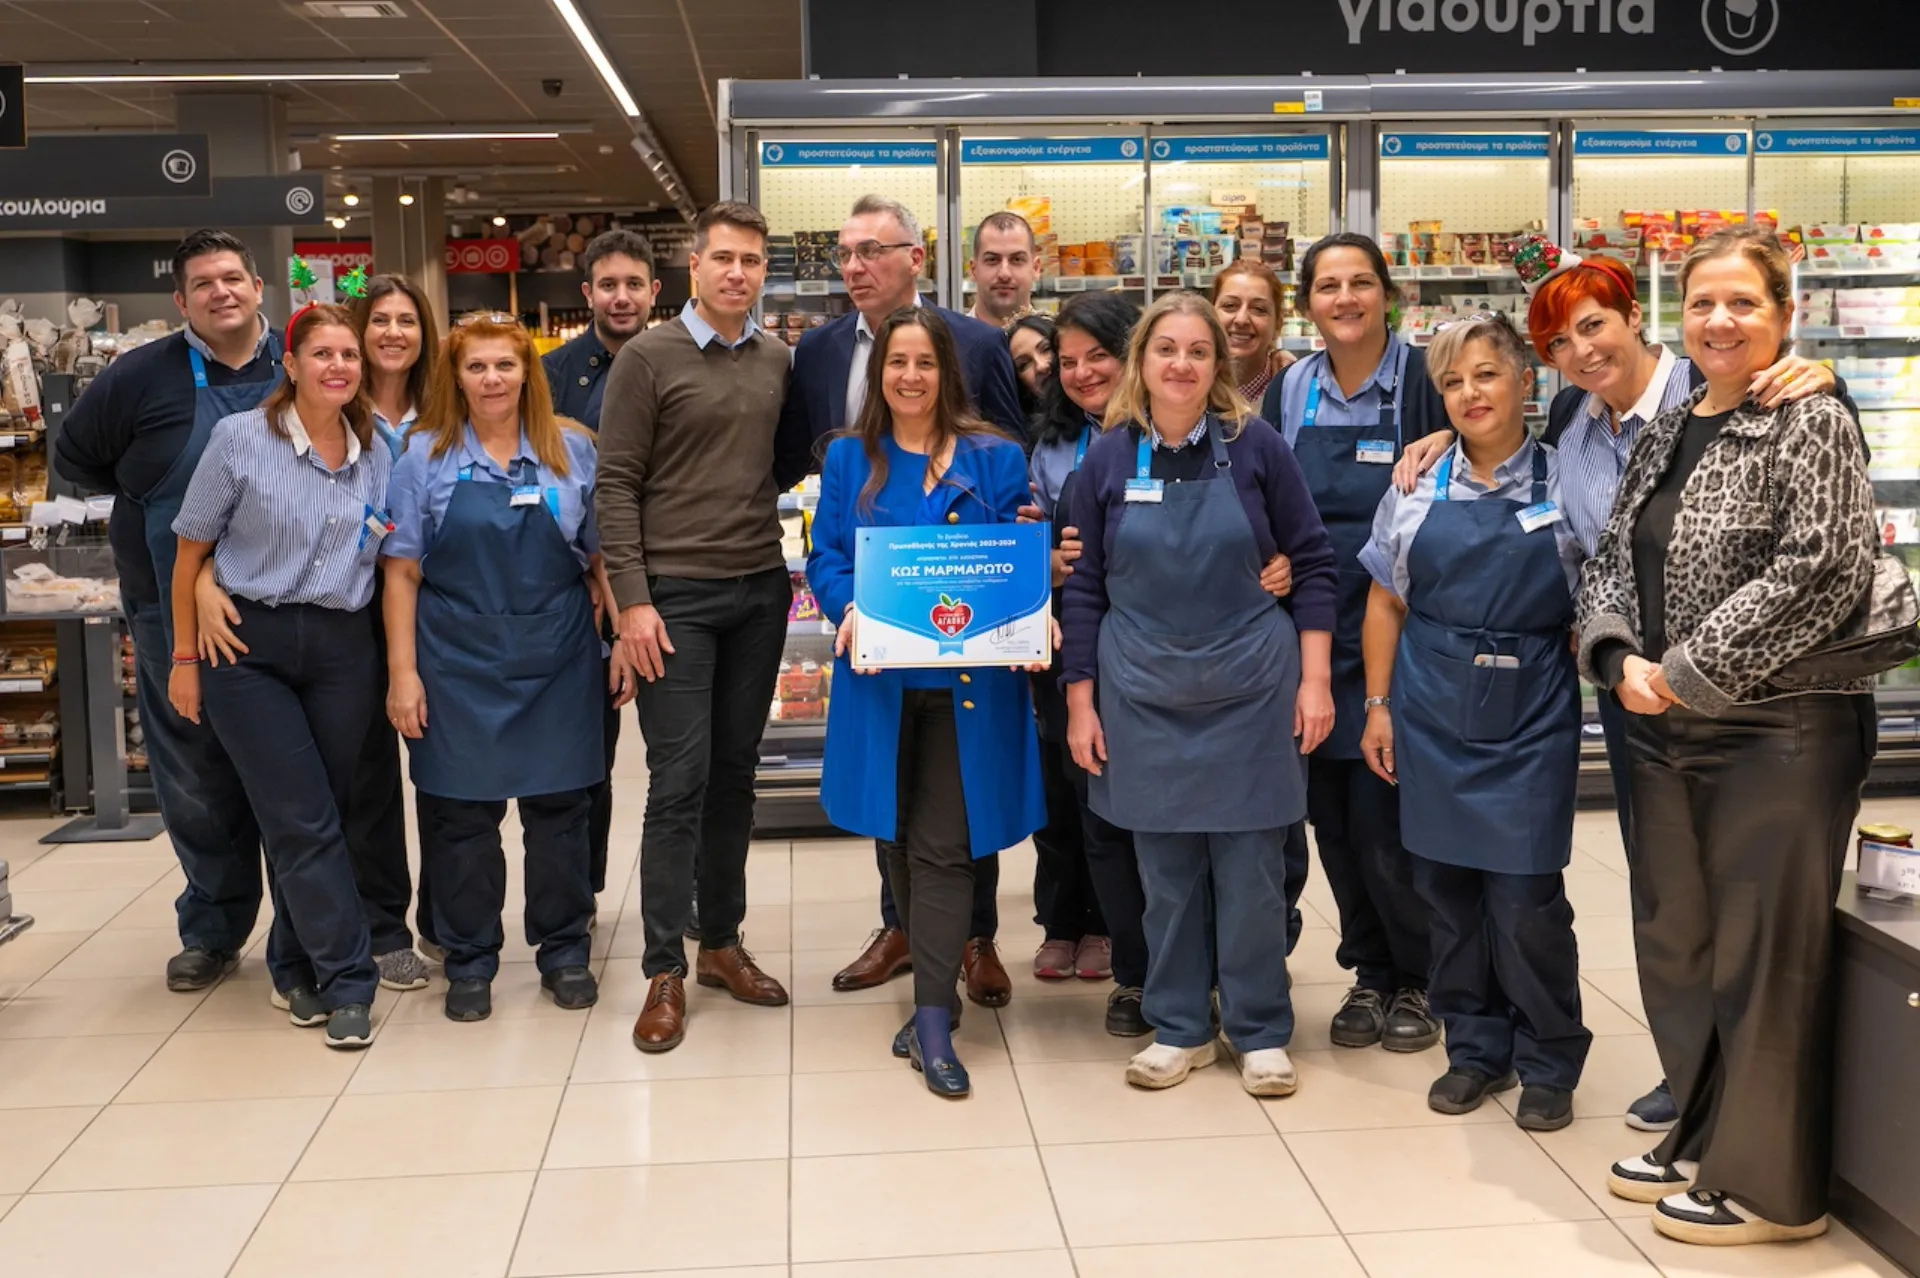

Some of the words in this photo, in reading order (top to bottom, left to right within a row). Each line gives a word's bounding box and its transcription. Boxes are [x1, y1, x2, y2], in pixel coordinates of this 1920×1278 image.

[1415, 140, 1489, 151] προστατεύουμε
[1492, 141, 1503, 150] τα
[1655, 136, 1698, 149] ενέργεια
[1786, 136, 1858, 146] προστατεύουμε
[1860, 137, 1872, 145] τα
[798, 148, 875, 159] προστατεύουμε
[878, 150, 890, 158] τα
[1046, 144, 1092, 156] ενέργεια
[1185, 143, 1259, 154] προστατεύουμε
[1262, 144, 1274, 152] τα
[1221, 193, 1246, 203] alpro
[0, 199, 106, 219] ουλούρια
[979, 539, 1016, 547] 2023-2024
[891, 566, 920, 577] ΚΩΣ
[924, 563, 1014, 577] ΜΑΡΜΑΡΩΤΟ
